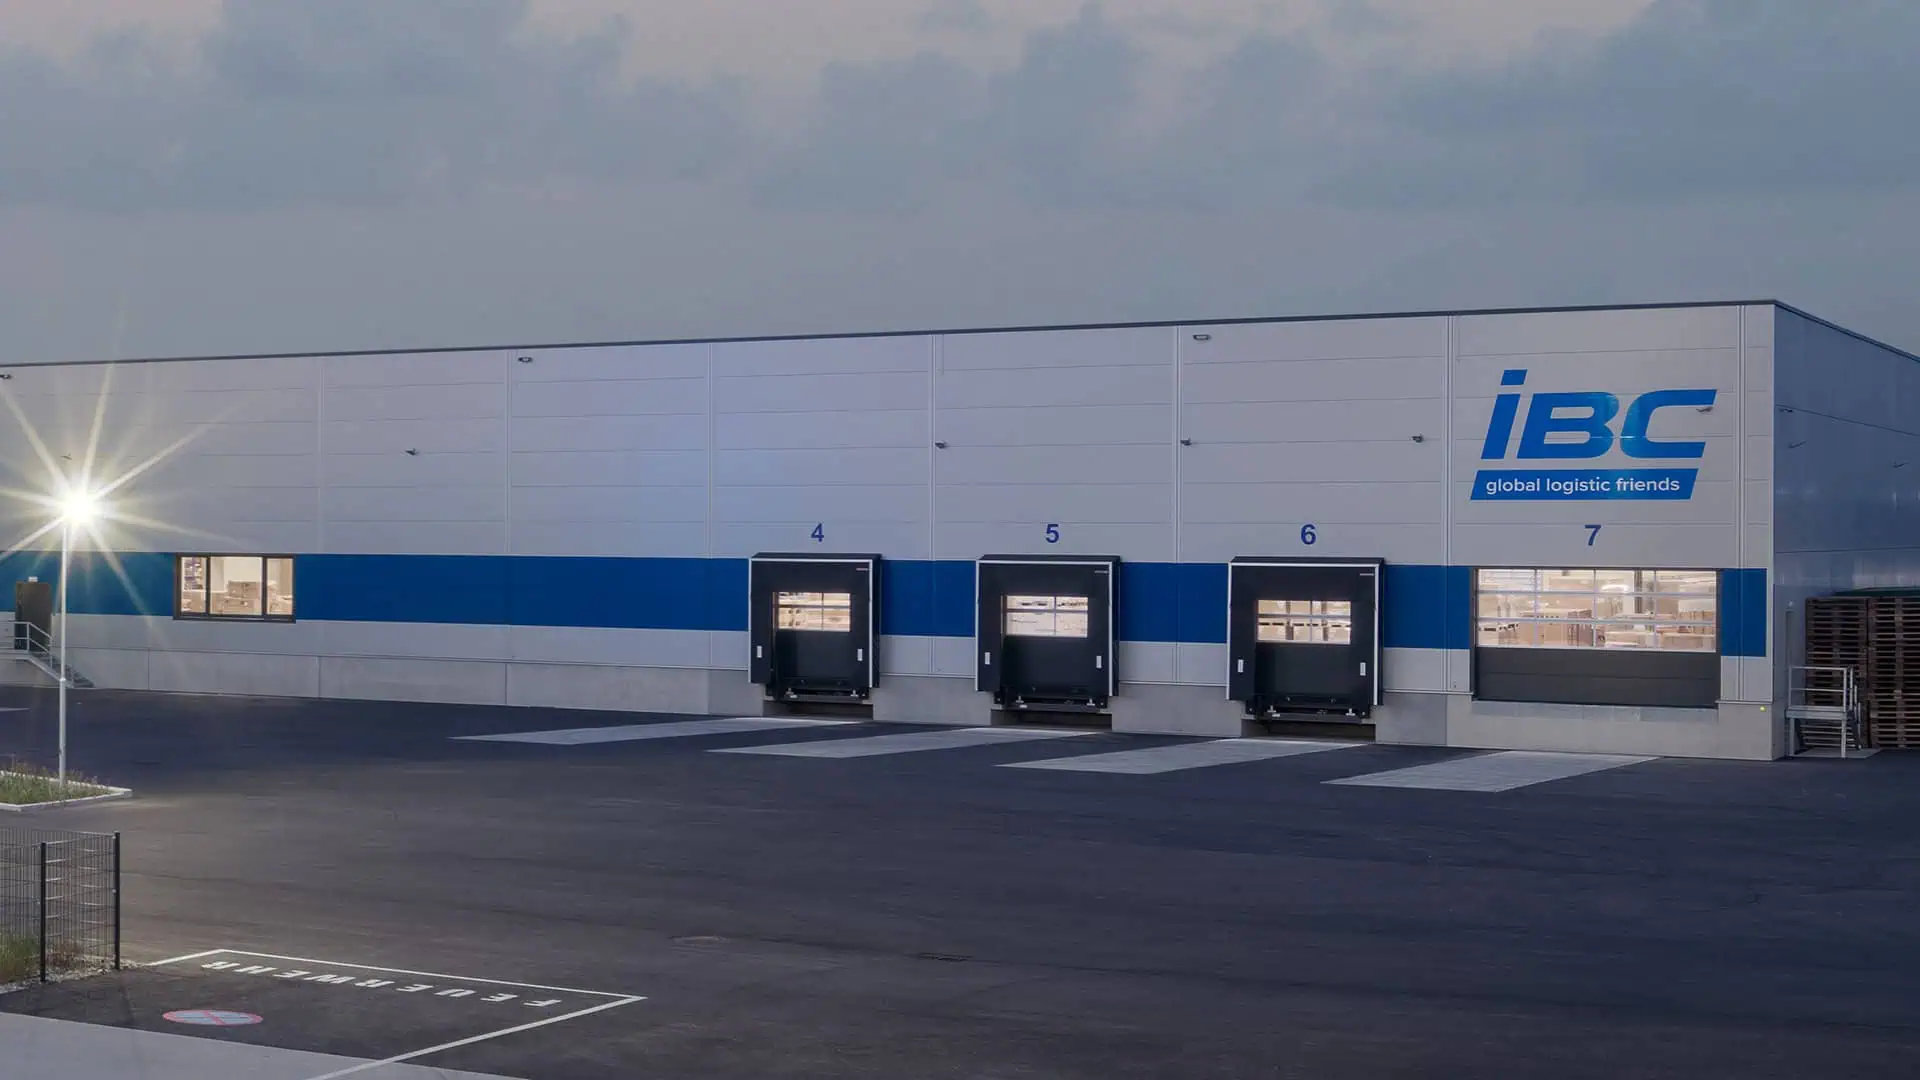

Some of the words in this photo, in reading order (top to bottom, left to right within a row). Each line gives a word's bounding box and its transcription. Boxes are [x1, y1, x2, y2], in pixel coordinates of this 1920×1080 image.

[1486, 478, 1540, 494] global
[1546, 477, 1610, 494] logistic
[1616, 477, 1680, 492] friends
[810, 523, 825, 542] 4
[1045, 523, 1060, 543] 5
[1300, 524, 1317, 545] 6
[1584, 524, 1602, 546] 7
[201, 960, 562, 1008] FEUERWEHR
